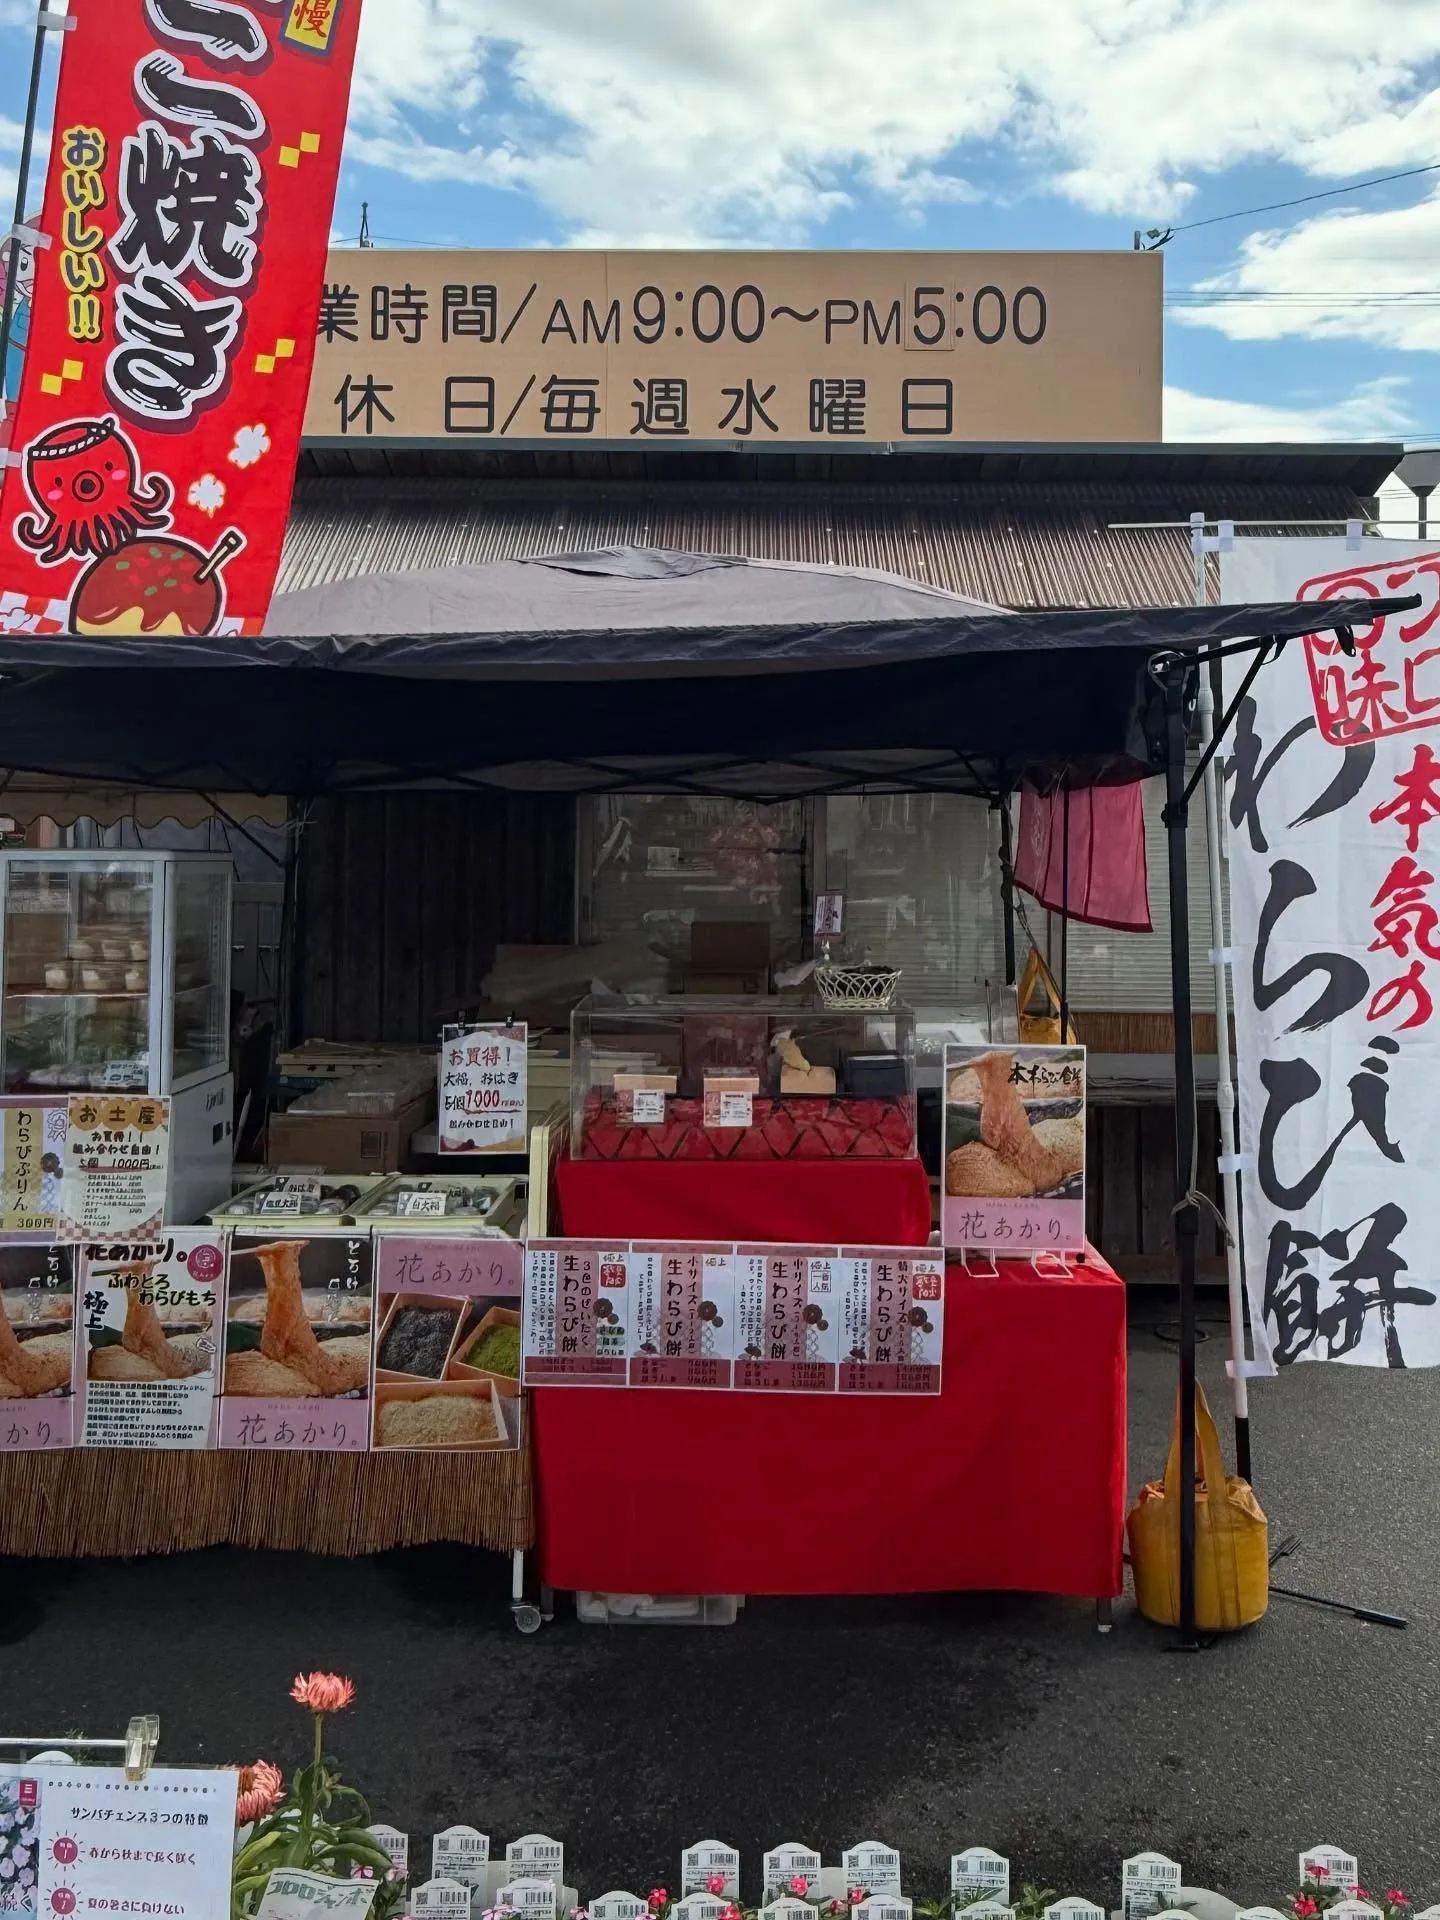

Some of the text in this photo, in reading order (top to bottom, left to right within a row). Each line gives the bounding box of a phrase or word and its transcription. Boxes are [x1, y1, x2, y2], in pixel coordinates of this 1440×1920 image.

[61, 125, 106, 340] おいしい!!
[1368, 744, 1440, 1031] 本気の
[1225, 695, 1436, 1369] わらび餅
[80, 1106, 156, 1125] お土産
[13, 1110, 32, 1212] わらびぷりん
[959, 1211, 1072, 1241] 花あかり。
[108, 1273, 171, 1290] ふわとろ
[139, 1289, 217, 1306] わらびもち
[396, 1252, 515, 1286] 花あかり。
[82, 1290, 110, 1330] 極上
[562, 1255, 580, 1353] 生わらび餅
[665, 1259, 683, 1357] 生わらび餅
[771, 1261, 788, 1360] 生わらび餅
[875, 1264, 893, 1363] 生わらび餅
[237, 1414, 359, 1446] 花あかり。
[87, 1898, 185, 1915] 夏の暑さに負けない
